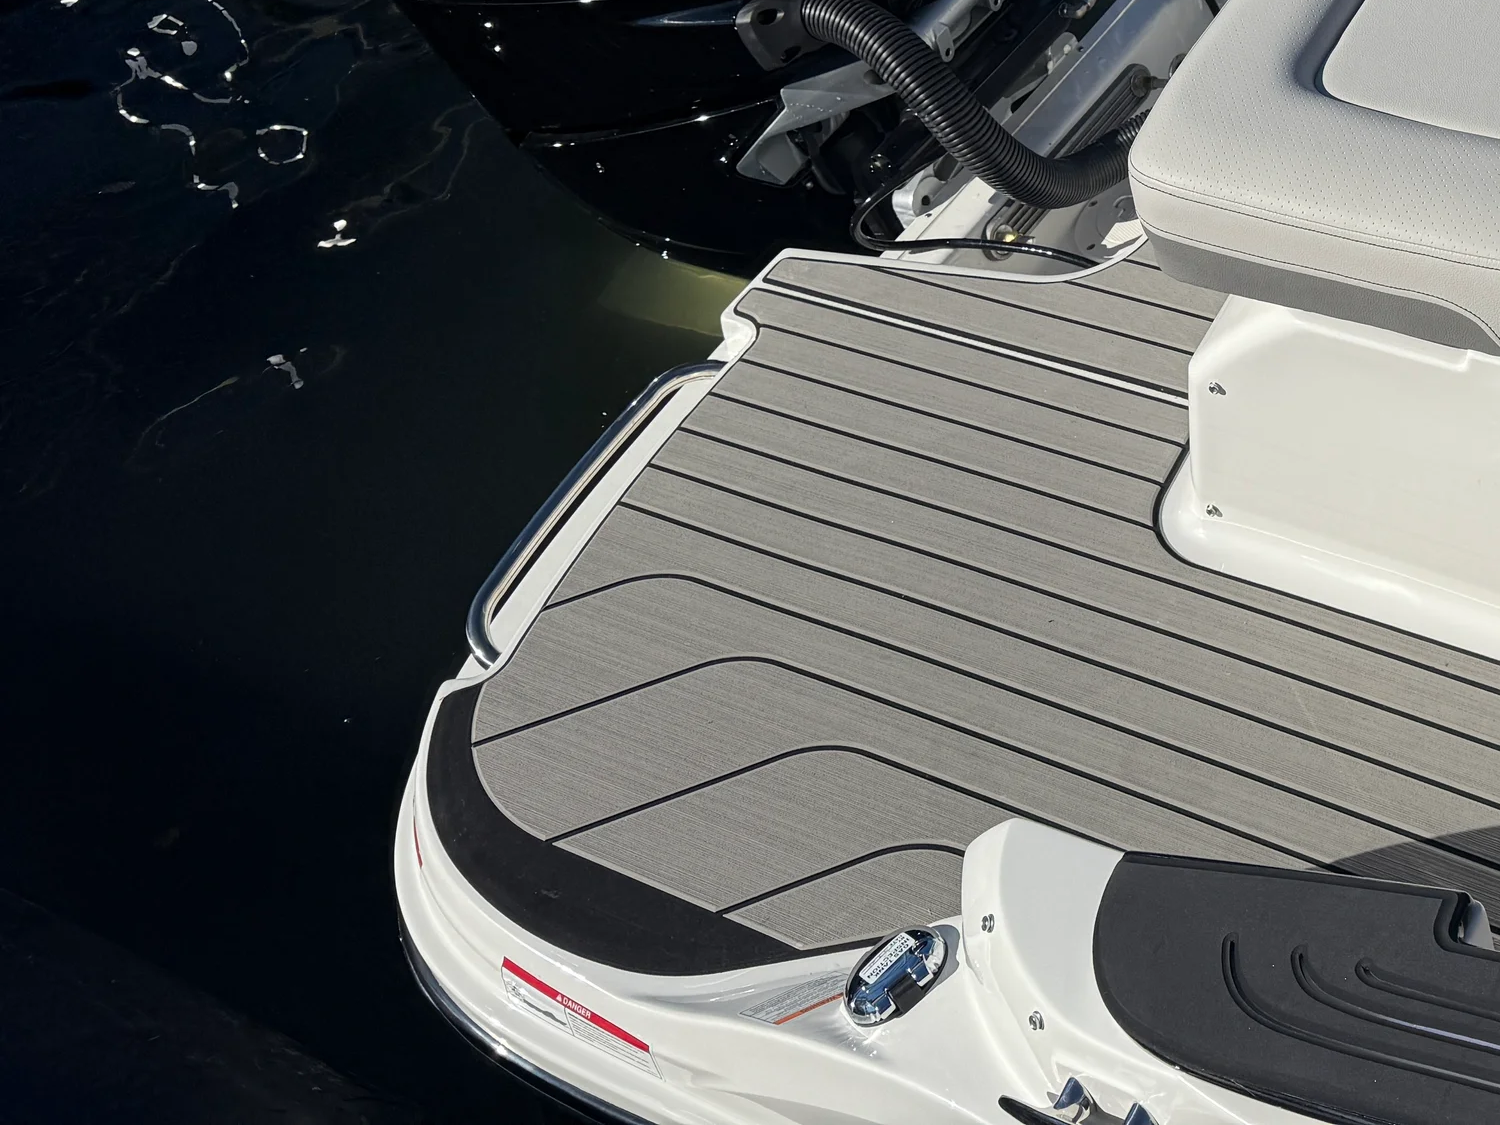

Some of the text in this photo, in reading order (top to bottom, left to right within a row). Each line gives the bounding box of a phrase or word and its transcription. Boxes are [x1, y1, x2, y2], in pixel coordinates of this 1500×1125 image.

[867, 937, 910, 979] INSPECTION
[874, 943, 909, 978] GAS TANK
[562, 997, 592, 1019] DANGER
